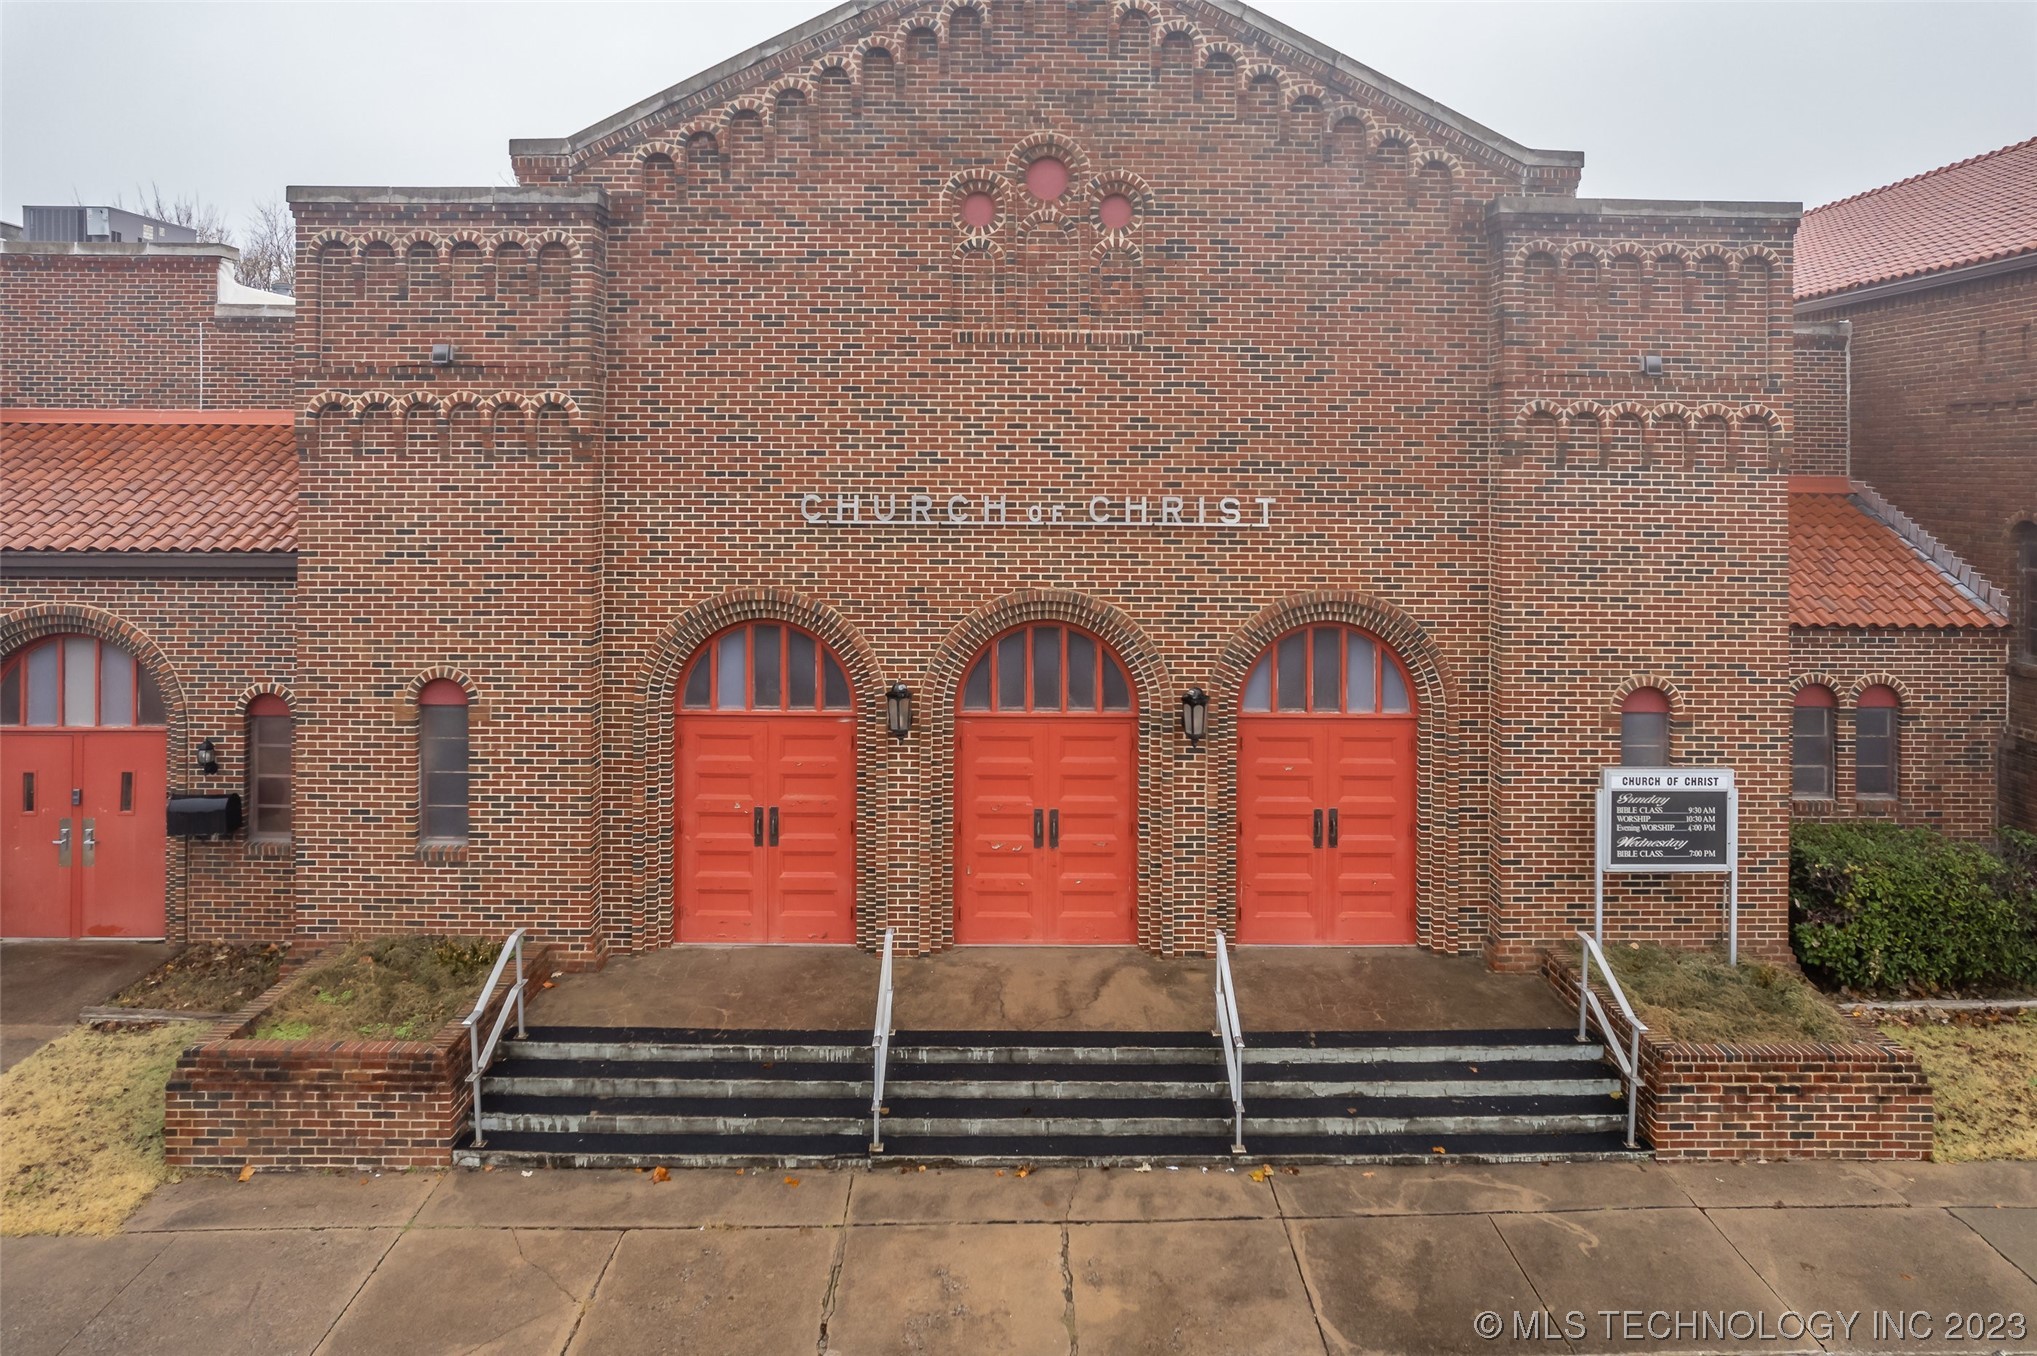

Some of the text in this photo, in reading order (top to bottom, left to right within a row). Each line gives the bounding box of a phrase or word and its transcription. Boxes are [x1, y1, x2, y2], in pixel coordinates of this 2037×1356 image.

[801, 494, 1006, 522] CHURCH
[1089, 496, 1276, 525] CHRIST
[1622, 776, 1719, 786] CHURCH OF CHRIST
[1617, 793, 1670, 806] Sunday
[1686, 815, 1702, 823] 10:30
[1703, 815, 1716, 823] AM
[1616, 824, 1640, 832] Evening
[1641, 824, 1675, 832] WORSHIP
[1616, 836, 1688, 850] Wednesday
